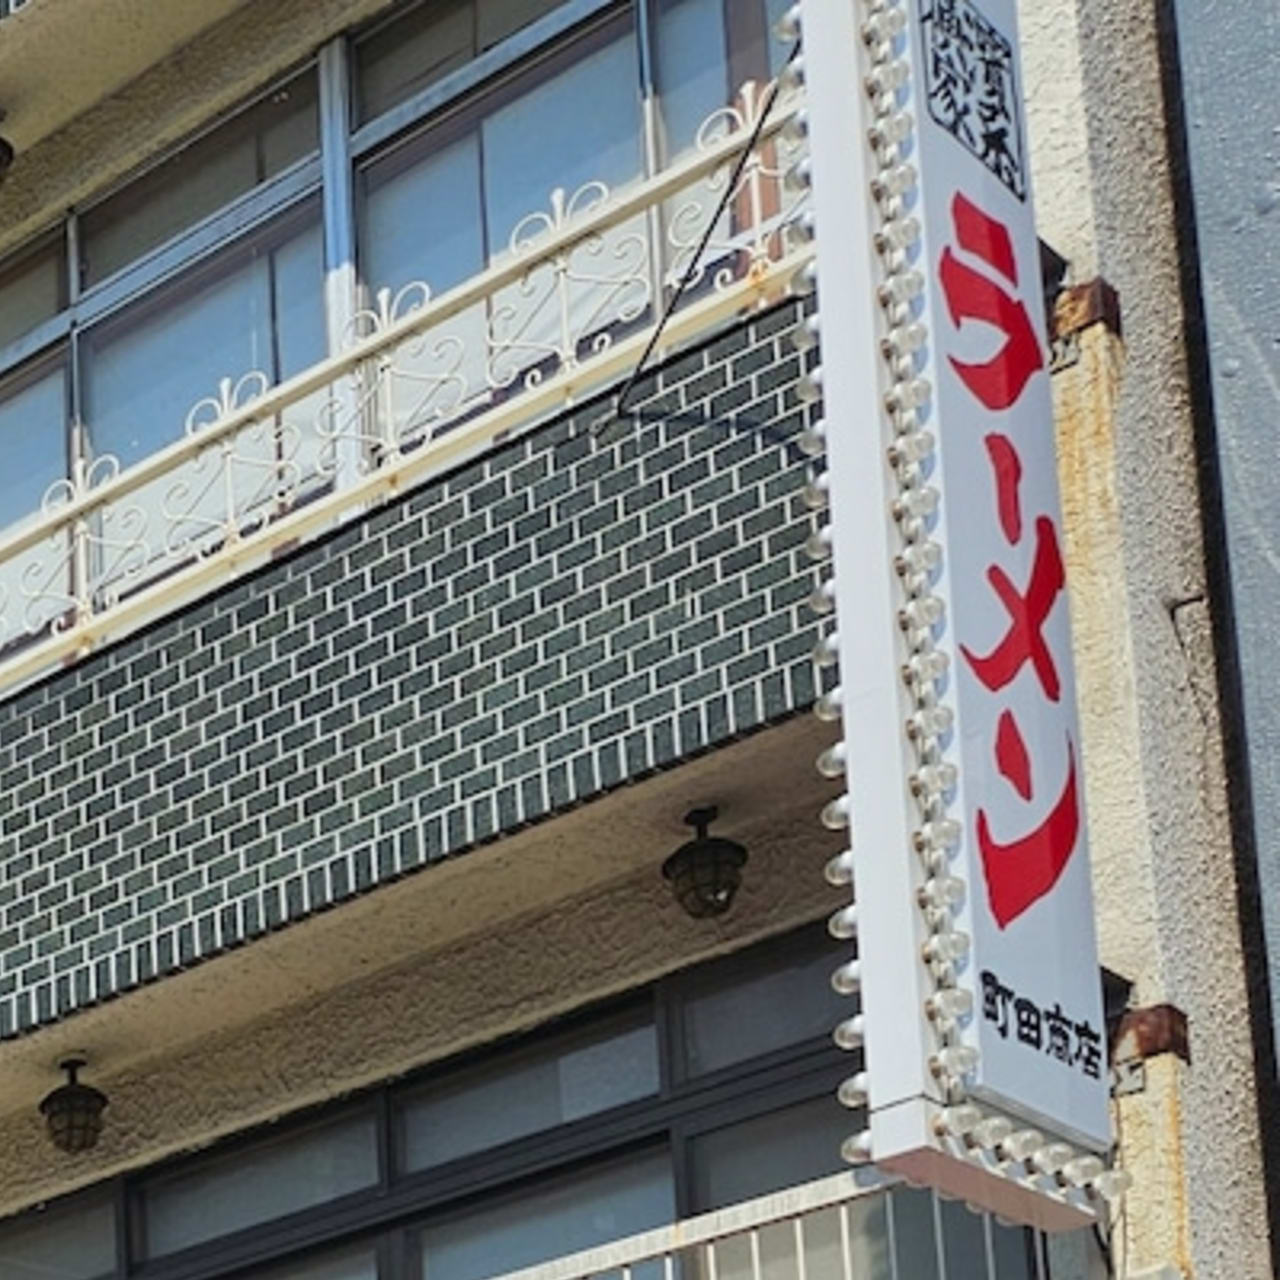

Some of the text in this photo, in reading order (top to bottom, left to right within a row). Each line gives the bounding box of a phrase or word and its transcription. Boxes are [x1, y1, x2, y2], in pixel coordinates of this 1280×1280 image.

[938, 190, 1081, 930] ラーメン
[979, 967, 1102, 1082] 町田商店
